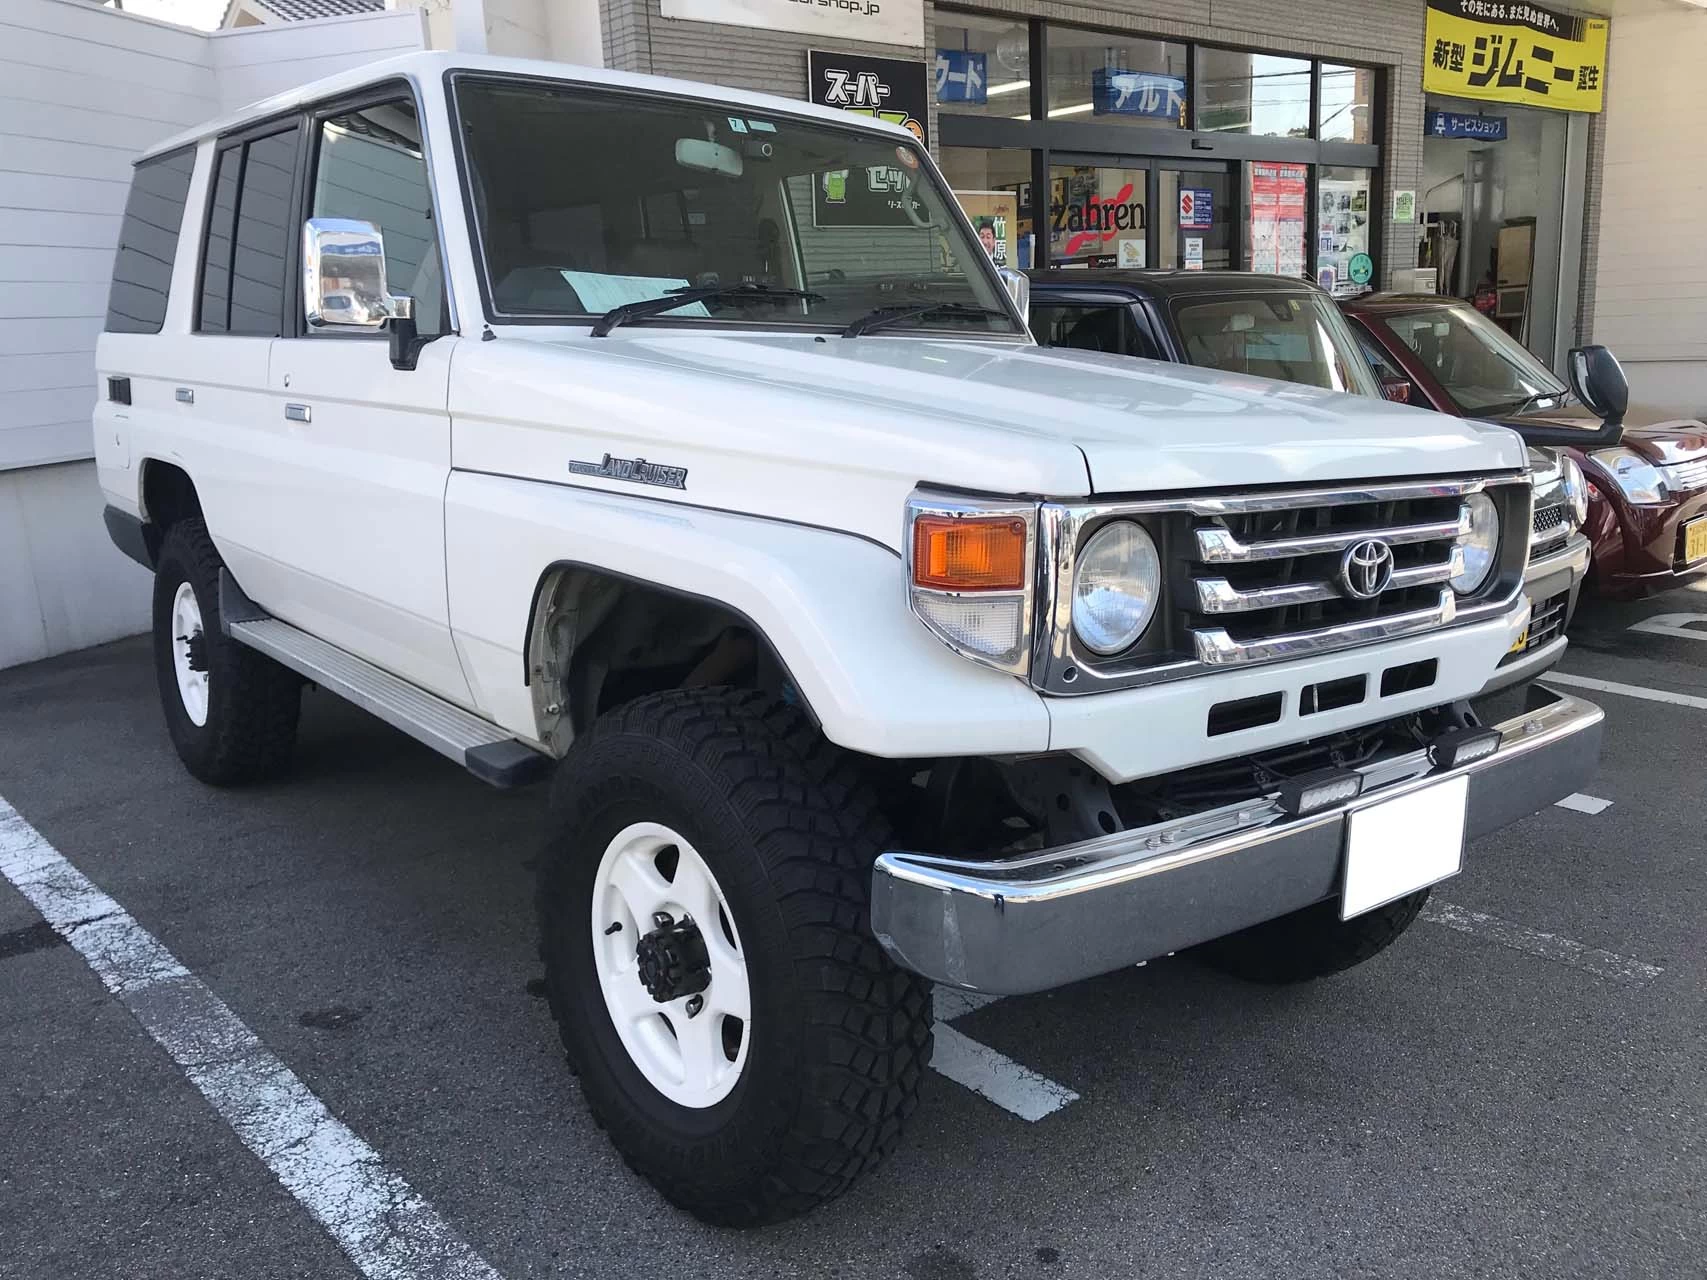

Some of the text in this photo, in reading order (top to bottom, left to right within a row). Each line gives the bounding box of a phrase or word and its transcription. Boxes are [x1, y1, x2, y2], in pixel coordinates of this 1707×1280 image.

[1432, 38, 1466, 73] 新型
[1467, 34, 1576, 95] ジムニー
[825, 69, 891, 106] スーパー
[1111, 75, 1182, 116] アルト
[1451, 116, 1501, 134] サービスショップ
[993, 216, 1007, 260] 竹原
